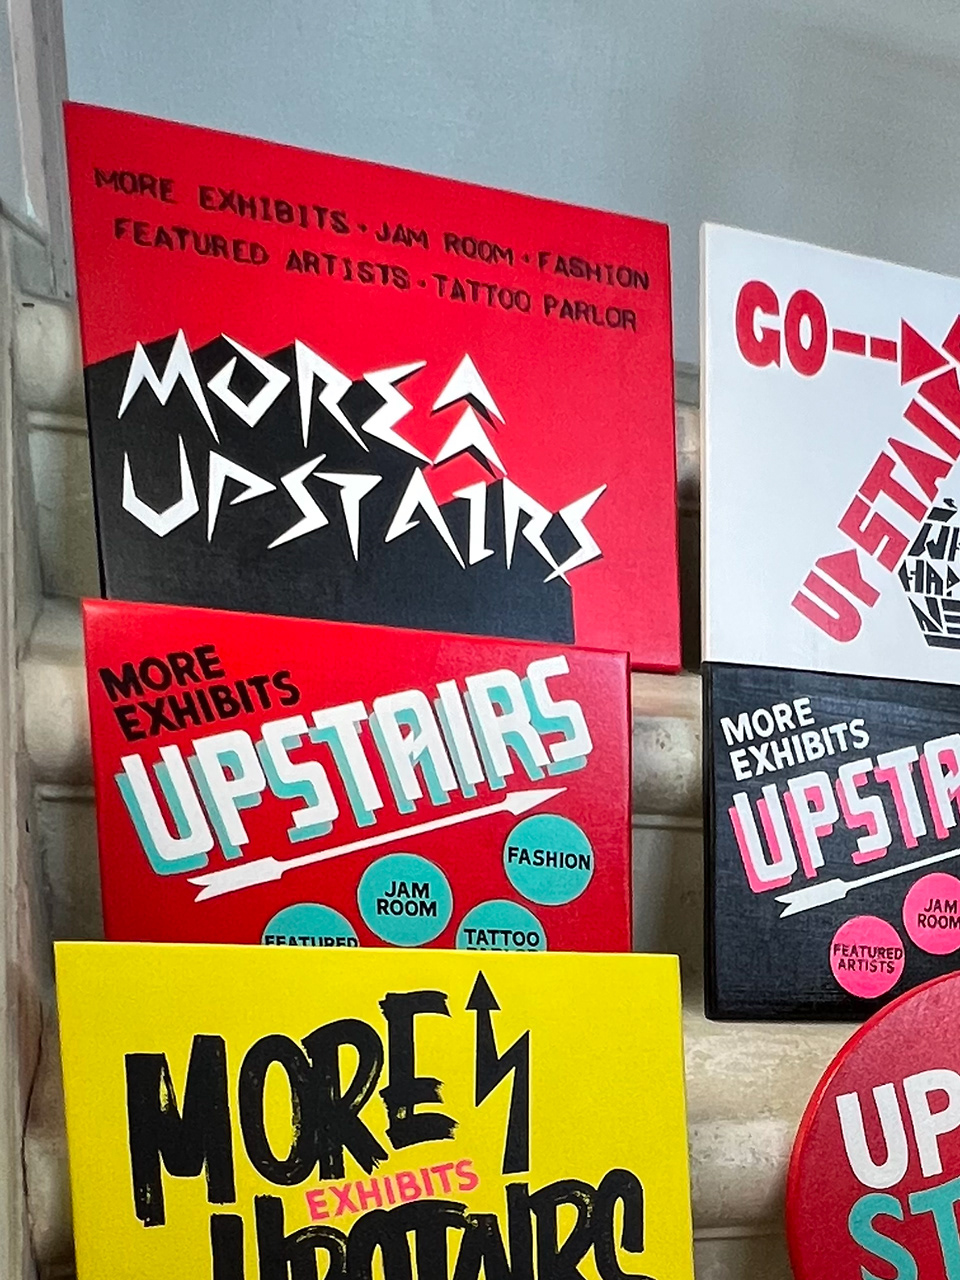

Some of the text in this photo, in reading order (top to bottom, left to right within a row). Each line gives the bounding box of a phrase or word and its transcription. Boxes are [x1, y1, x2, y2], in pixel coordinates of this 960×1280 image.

[94, 168, 650, 291] MORE EXHIBITS JAM ROOM FASHION
[114, 218, 637, 332] FEATURED ARTISTS TATTOO PARLOR
[735, 280, 827, 376] GO
[118, 328, 434, 465] MORE
[122, 435, 607, 586] UPSTAIRS
[99, 644, 225, 703] MORE
[113, 671, 301, 742] EXHIBITS
[720, 697, 815, 746] MORE
[114, 655, 593, 876] UPSTAIRS
[729, 719, 870, 781] EXHIBITS
[507, 846, 592, 871] FASHION
[376, 898, 437, 917] ROOM
[384, 880, 430, 900] JAM
[924, 899, 958, 913] JAM
[464, 928, 540, 947] TATTOO
[834, 943, 903, 960] FEATURED
[838, 958, 895, 974] ARTISTS
[124, 990, 457, 1228] MORE
[305, 1158, 480, 1221] EXHIBITS
